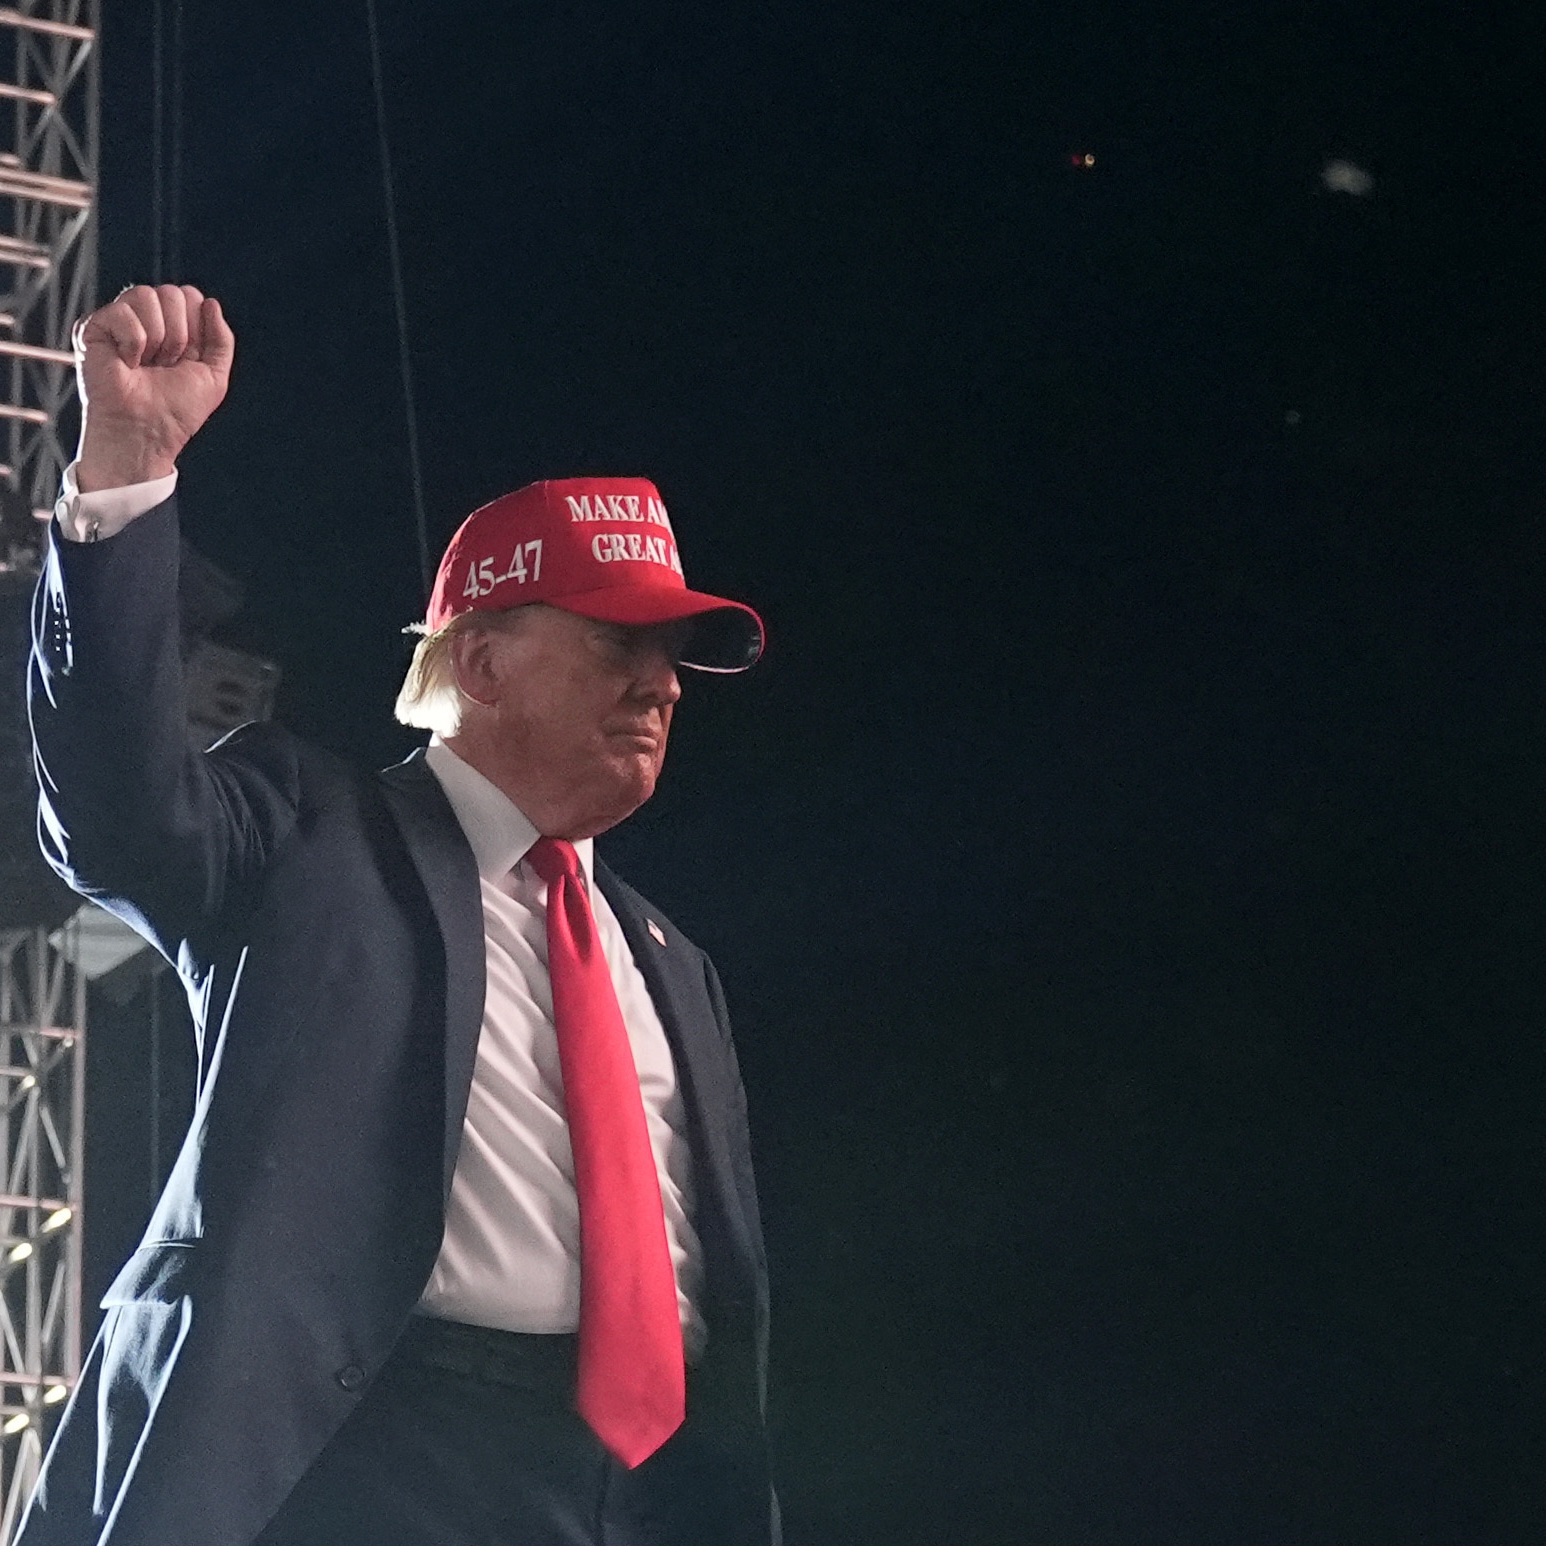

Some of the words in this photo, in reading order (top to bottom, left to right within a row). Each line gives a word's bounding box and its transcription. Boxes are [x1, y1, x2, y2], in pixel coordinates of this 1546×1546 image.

[565, 494, 645, 523] MAKE
[591, 532, 669, 567] GREAT
[462, 538, 543, 600] 45-47
